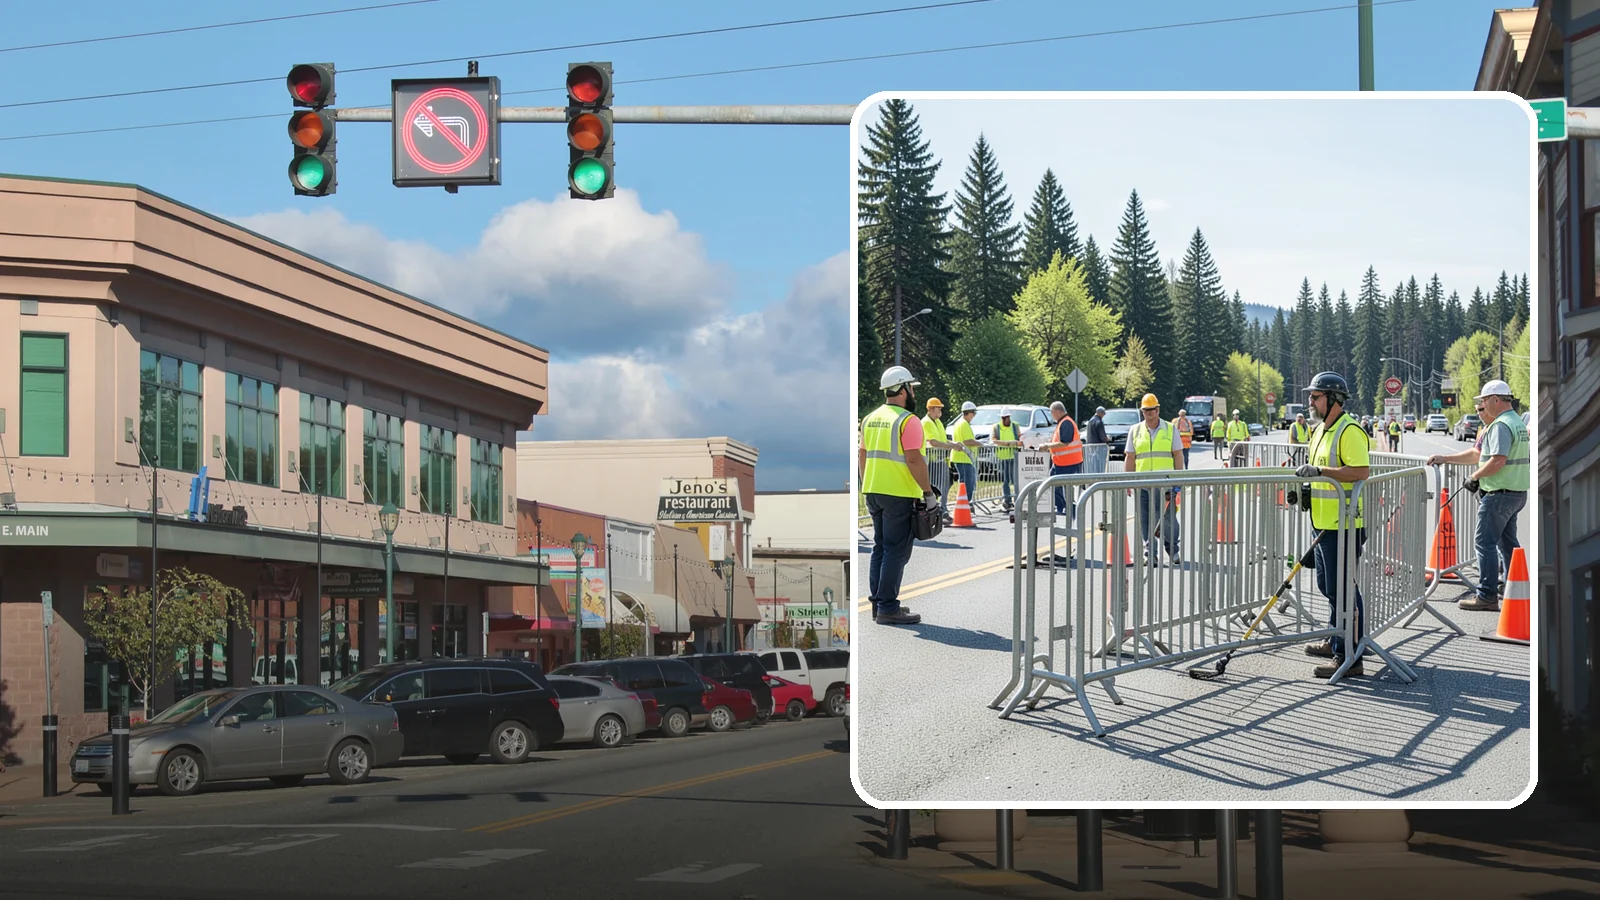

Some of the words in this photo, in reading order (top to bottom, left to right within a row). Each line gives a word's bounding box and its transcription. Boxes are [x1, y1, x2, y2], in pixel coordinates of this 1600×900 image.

[669, 479, 727, 495] Jeno's
[665, 496, 731, 509] restaurant
[658, 509, 681, 519] Italian
[686, 509, 714, 519] American
[714, 509, 737, 519] Cuisine
[2, 525, 13, 536] E.
[15, 525, 49, 536] MAIN
[797, 607, 828, 617] Street
